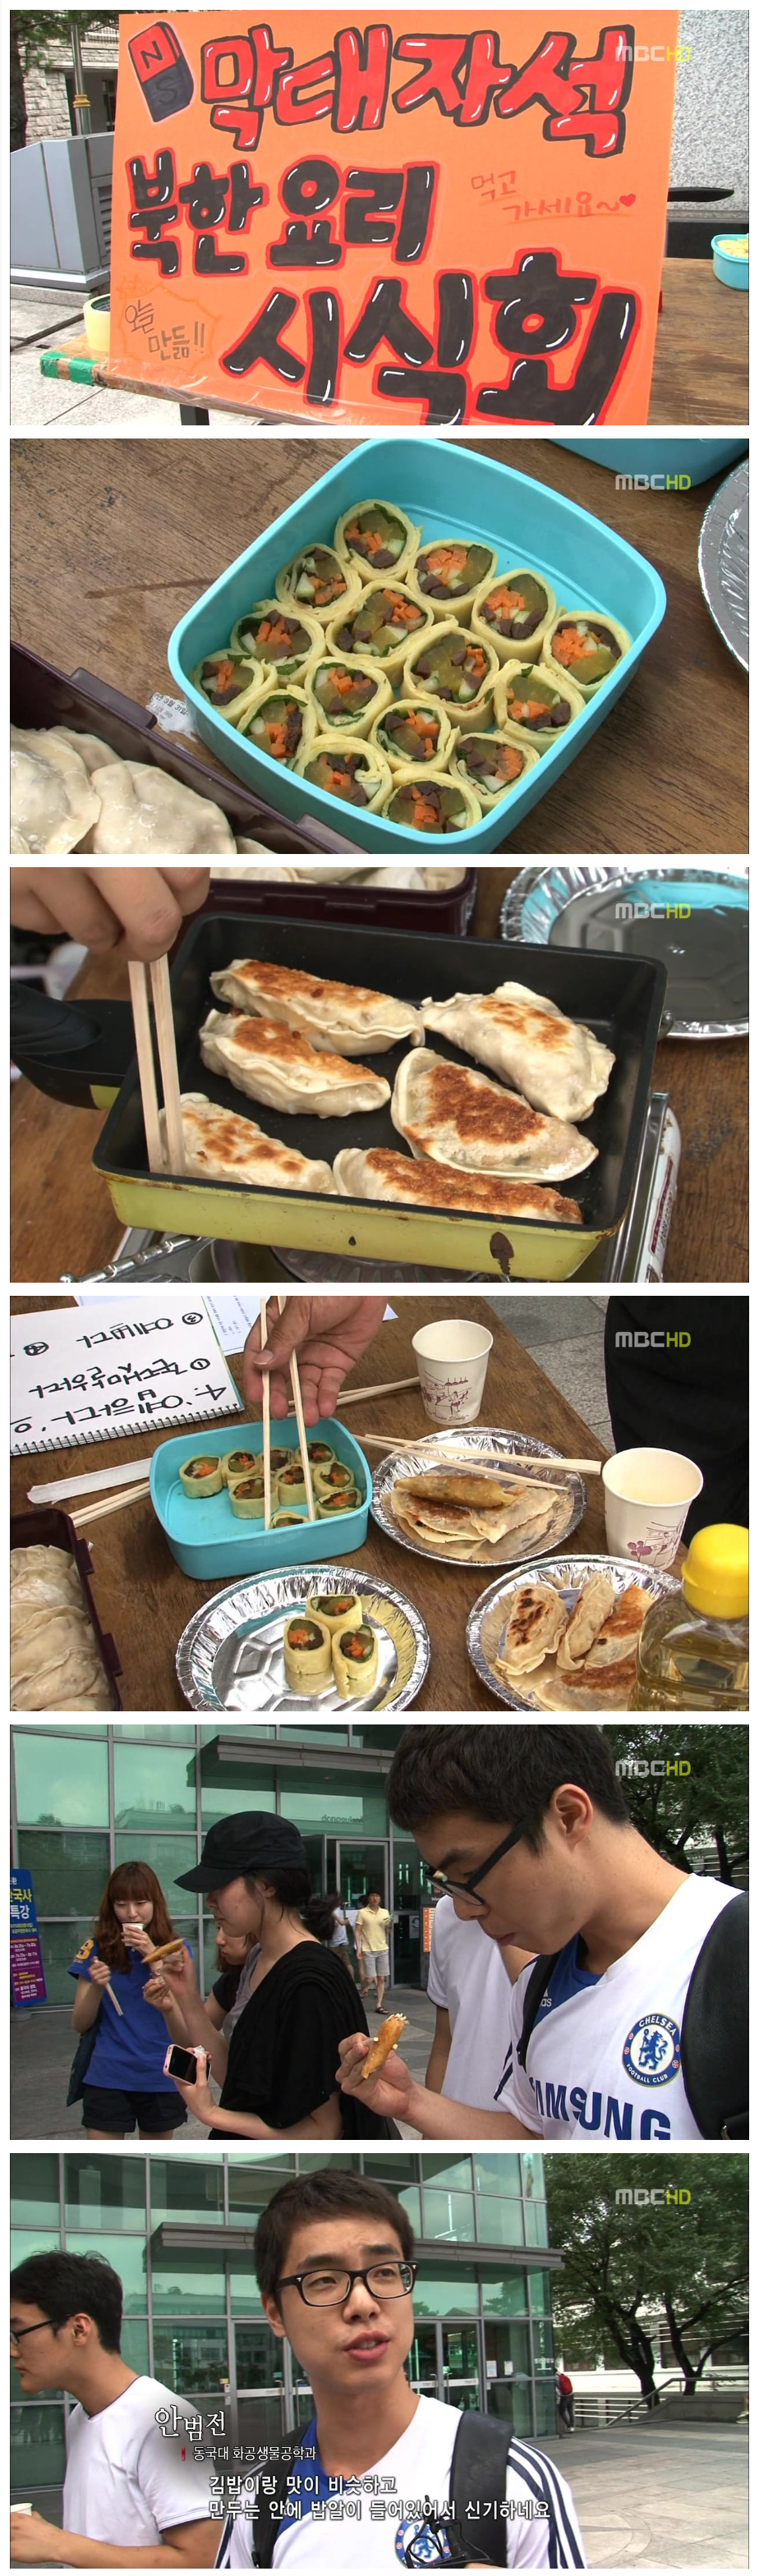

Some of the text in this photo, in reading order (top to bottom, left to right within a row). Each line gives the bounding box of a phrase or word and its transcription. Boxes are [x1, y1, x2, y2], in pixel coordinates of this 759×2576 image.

[140, 39, 163, 70] N
[200, 24, 634, 158] 막대자석
[471, 170, 518, 201] 먹고
[125, 299, 154, 334] 오늘
[218, 248, 642, 425] 시식회
[638, 2015, 676, 2036] CHELSEA
[626, 2063, 669, 2083] FOOTBALL CLUB
